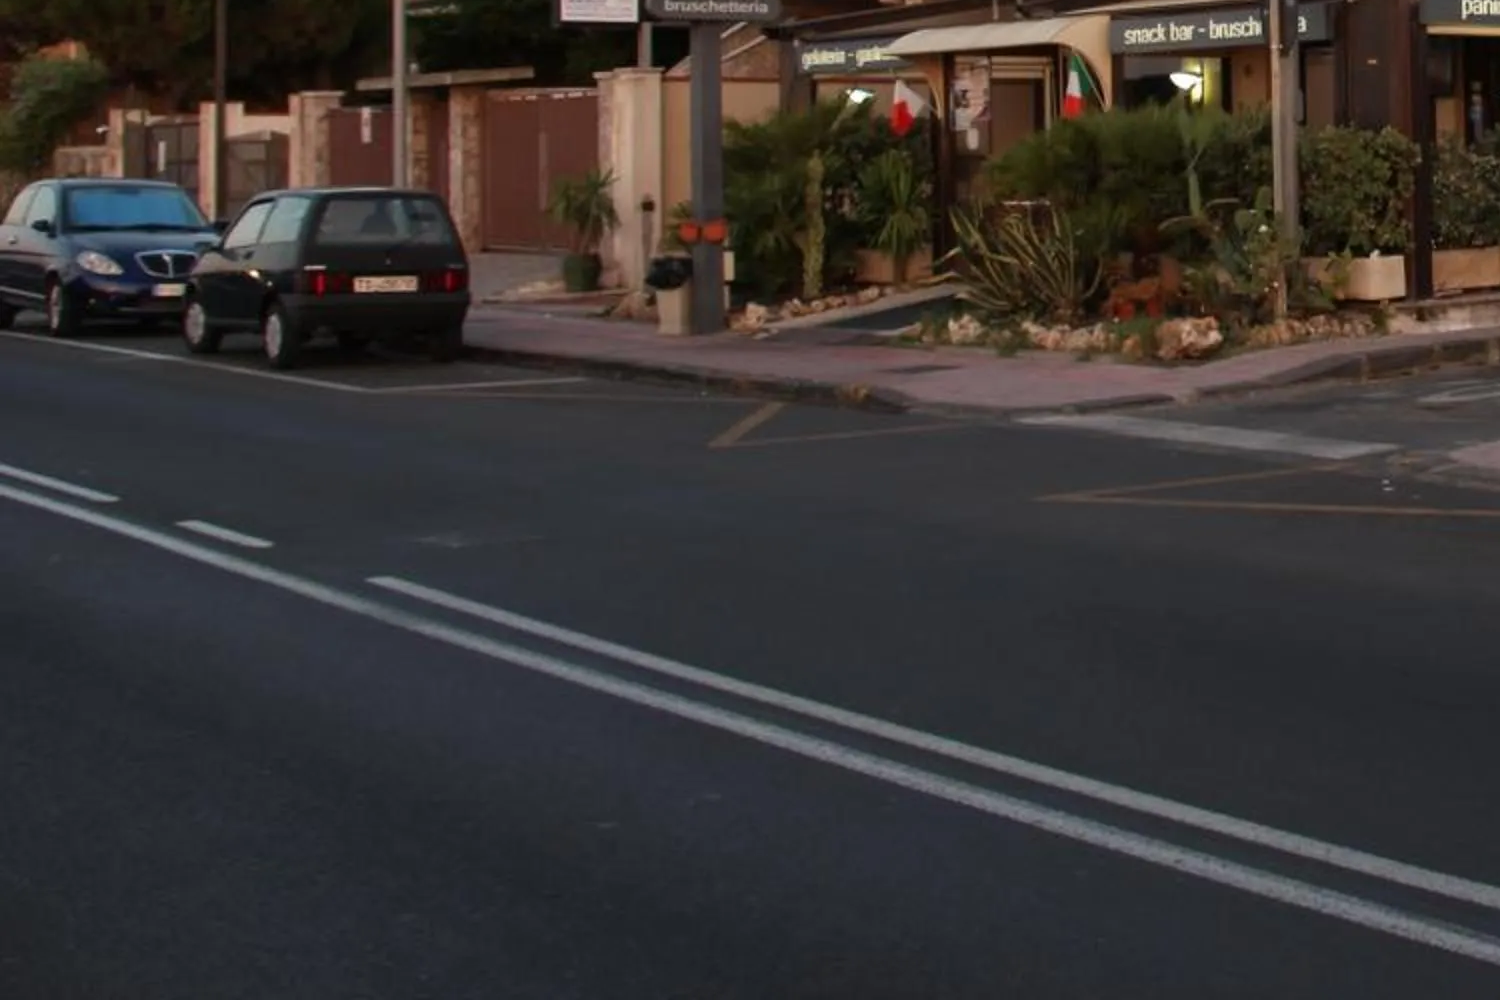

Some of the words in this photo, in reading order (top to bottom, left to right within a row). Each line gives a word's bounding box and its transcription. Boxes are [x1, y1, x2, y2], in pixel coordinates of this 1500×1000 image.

[664, 0, 768, 13] bruschetteria
[1123, 24, 1166, 45] snack
[1169, 21, 1195, 41] bar
